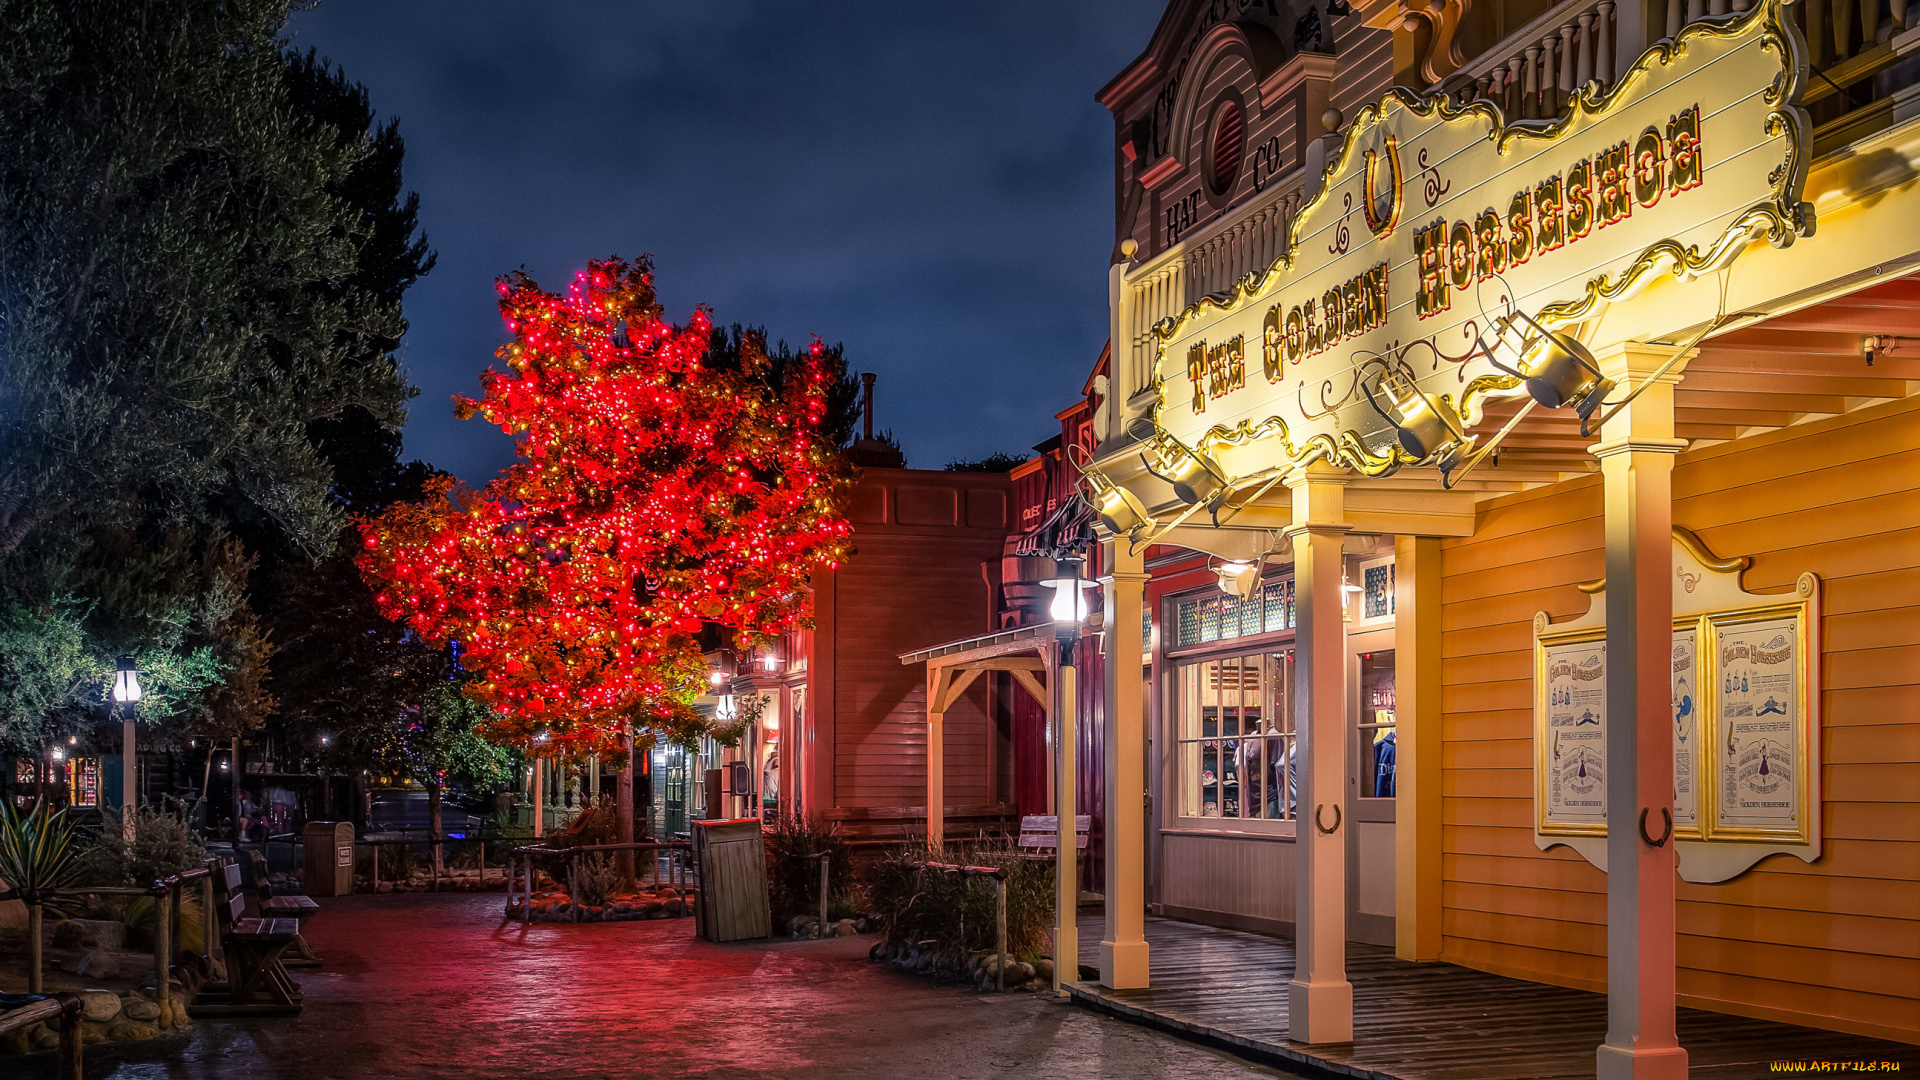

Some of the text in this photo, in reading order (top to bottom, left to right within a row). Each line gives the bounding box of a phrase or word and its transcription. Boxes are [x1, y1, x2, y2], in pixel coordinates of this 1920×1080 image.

[1165, 136, 1283, 249] HAT CO.
[1187, 104, 1703, 415] THE GOLDEN HORSESHOE
[1549, 665, 1571, 683] GOLDEN
[1722, 644, 1791, 668] GOLDEN HORSESHOE
